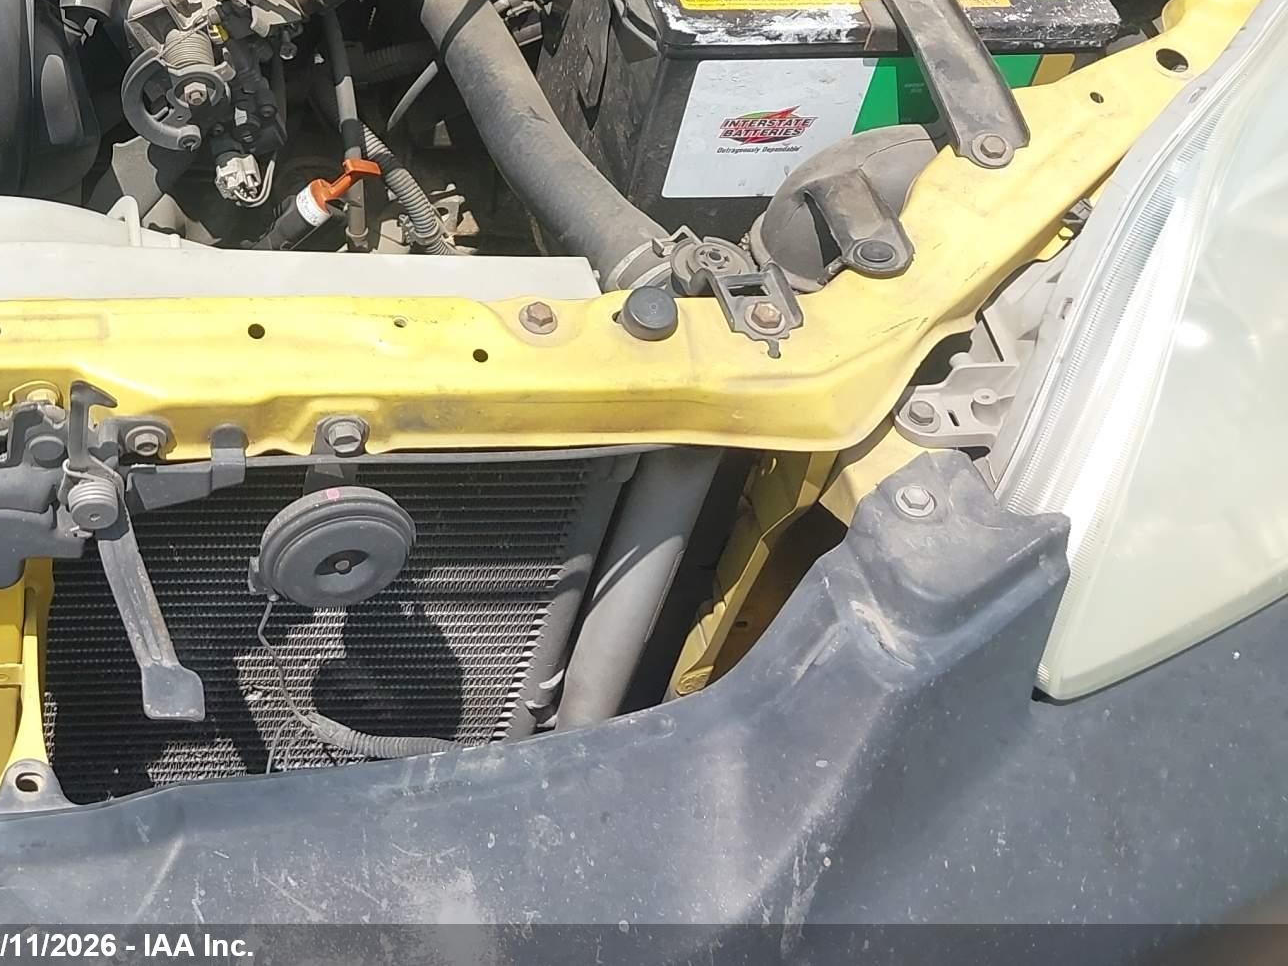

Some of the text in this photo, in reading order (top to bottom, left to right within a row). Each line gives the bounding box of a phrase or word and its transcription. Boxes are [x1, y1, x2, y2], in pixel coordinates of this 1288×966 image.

[723, 118, 812, 128] INTERSTATE
[722, 128, 803, 138] BATTERIES
[716, 146, 761, 154] Outrageously
